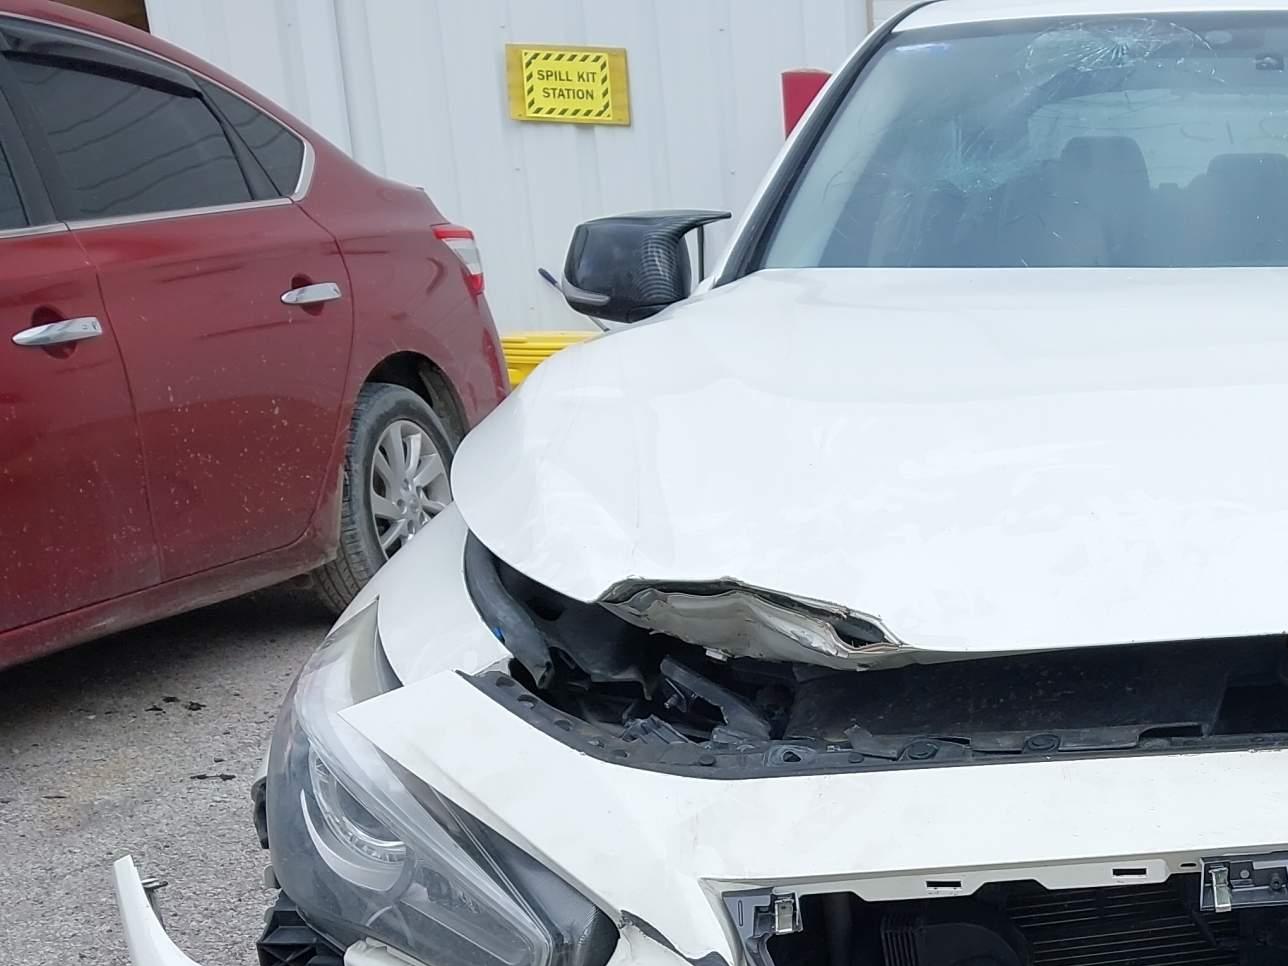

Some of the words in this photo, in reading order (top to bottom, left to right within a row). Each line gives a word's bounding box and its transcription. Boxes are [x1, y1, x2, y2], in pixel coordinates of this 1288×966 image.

[537, 69, 573, 82] SPILL
[577, 71, 597, 83] KIT
[542, 87, 595, 100] STATION
